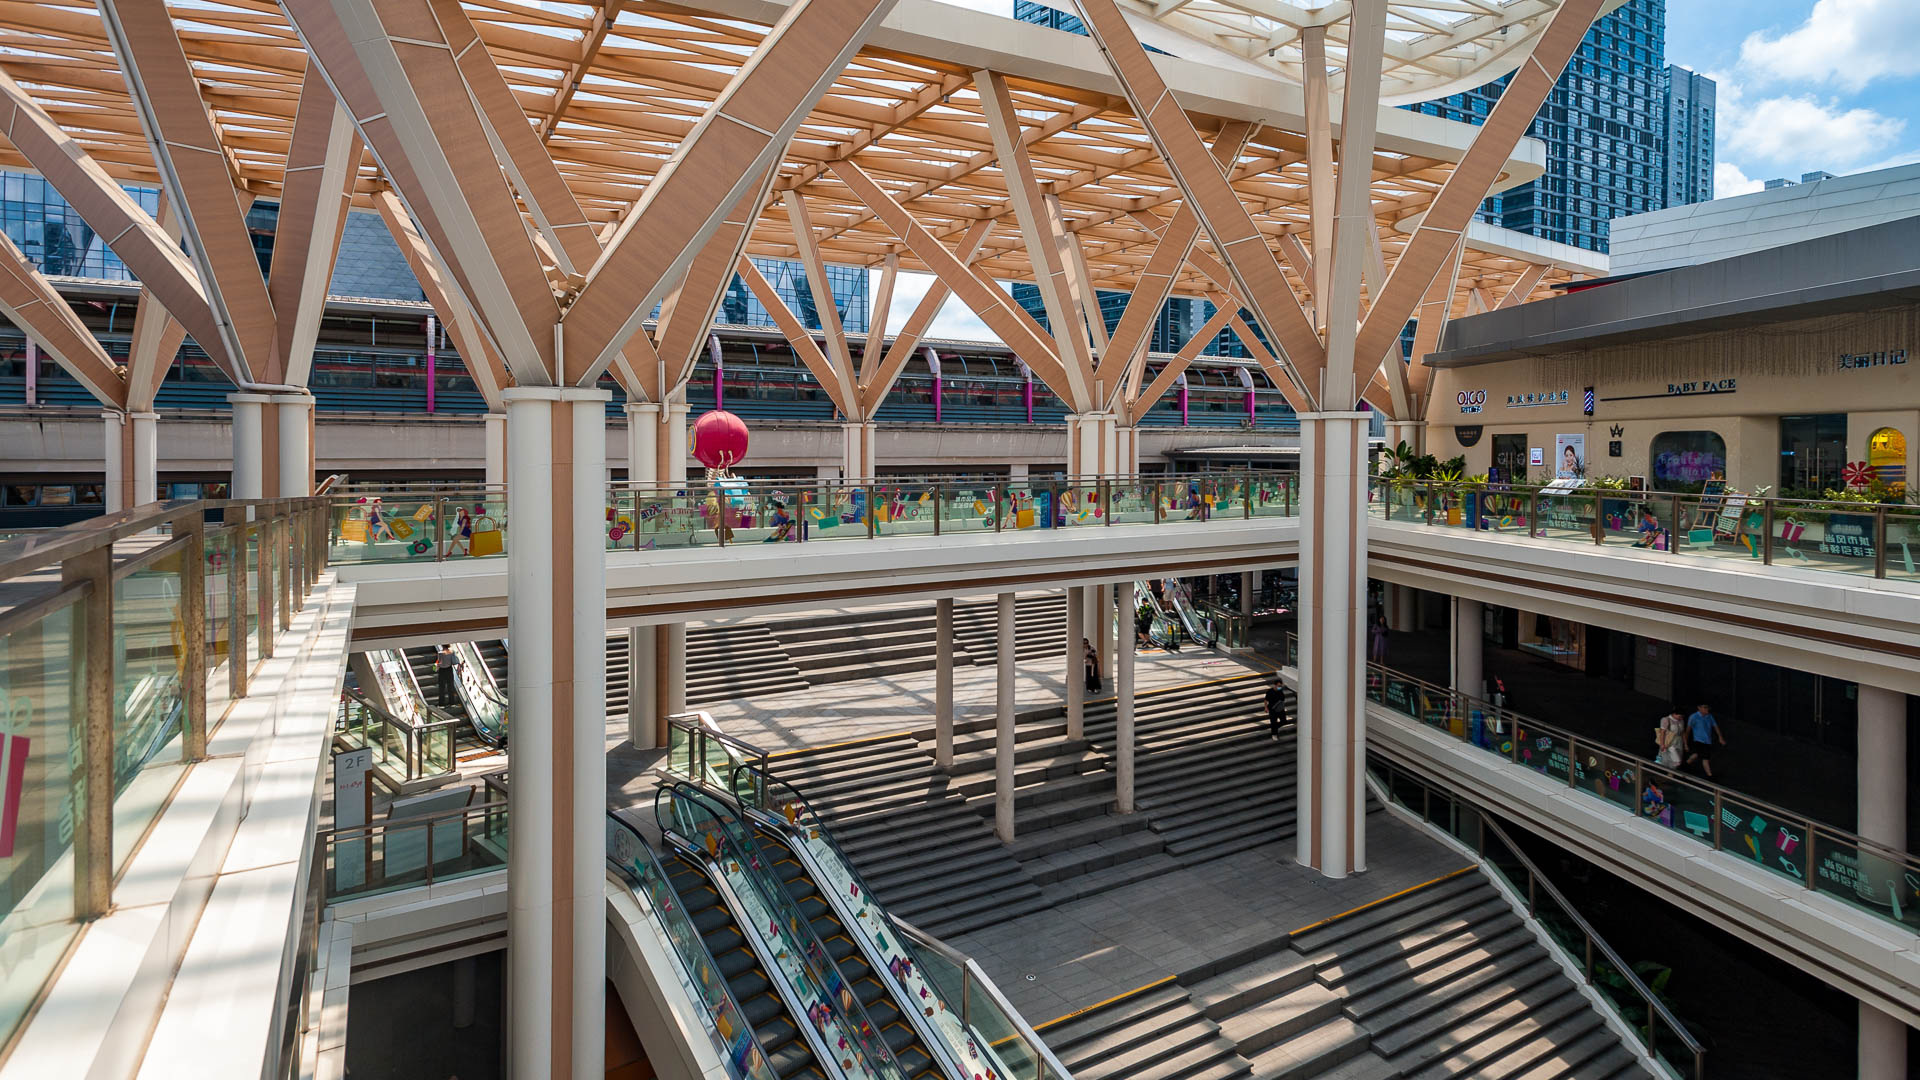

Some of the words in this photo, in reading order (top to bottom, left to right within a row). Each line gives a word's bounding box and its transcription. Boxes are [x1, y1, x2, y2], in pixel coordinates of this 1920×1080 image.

[1839, 348, 1907, 369] 美丽日记
[1667, 382, 1698, 395] BABY
[1702, 379, 1736, 393] FACE
[345, 757, 364, 769] 2F
